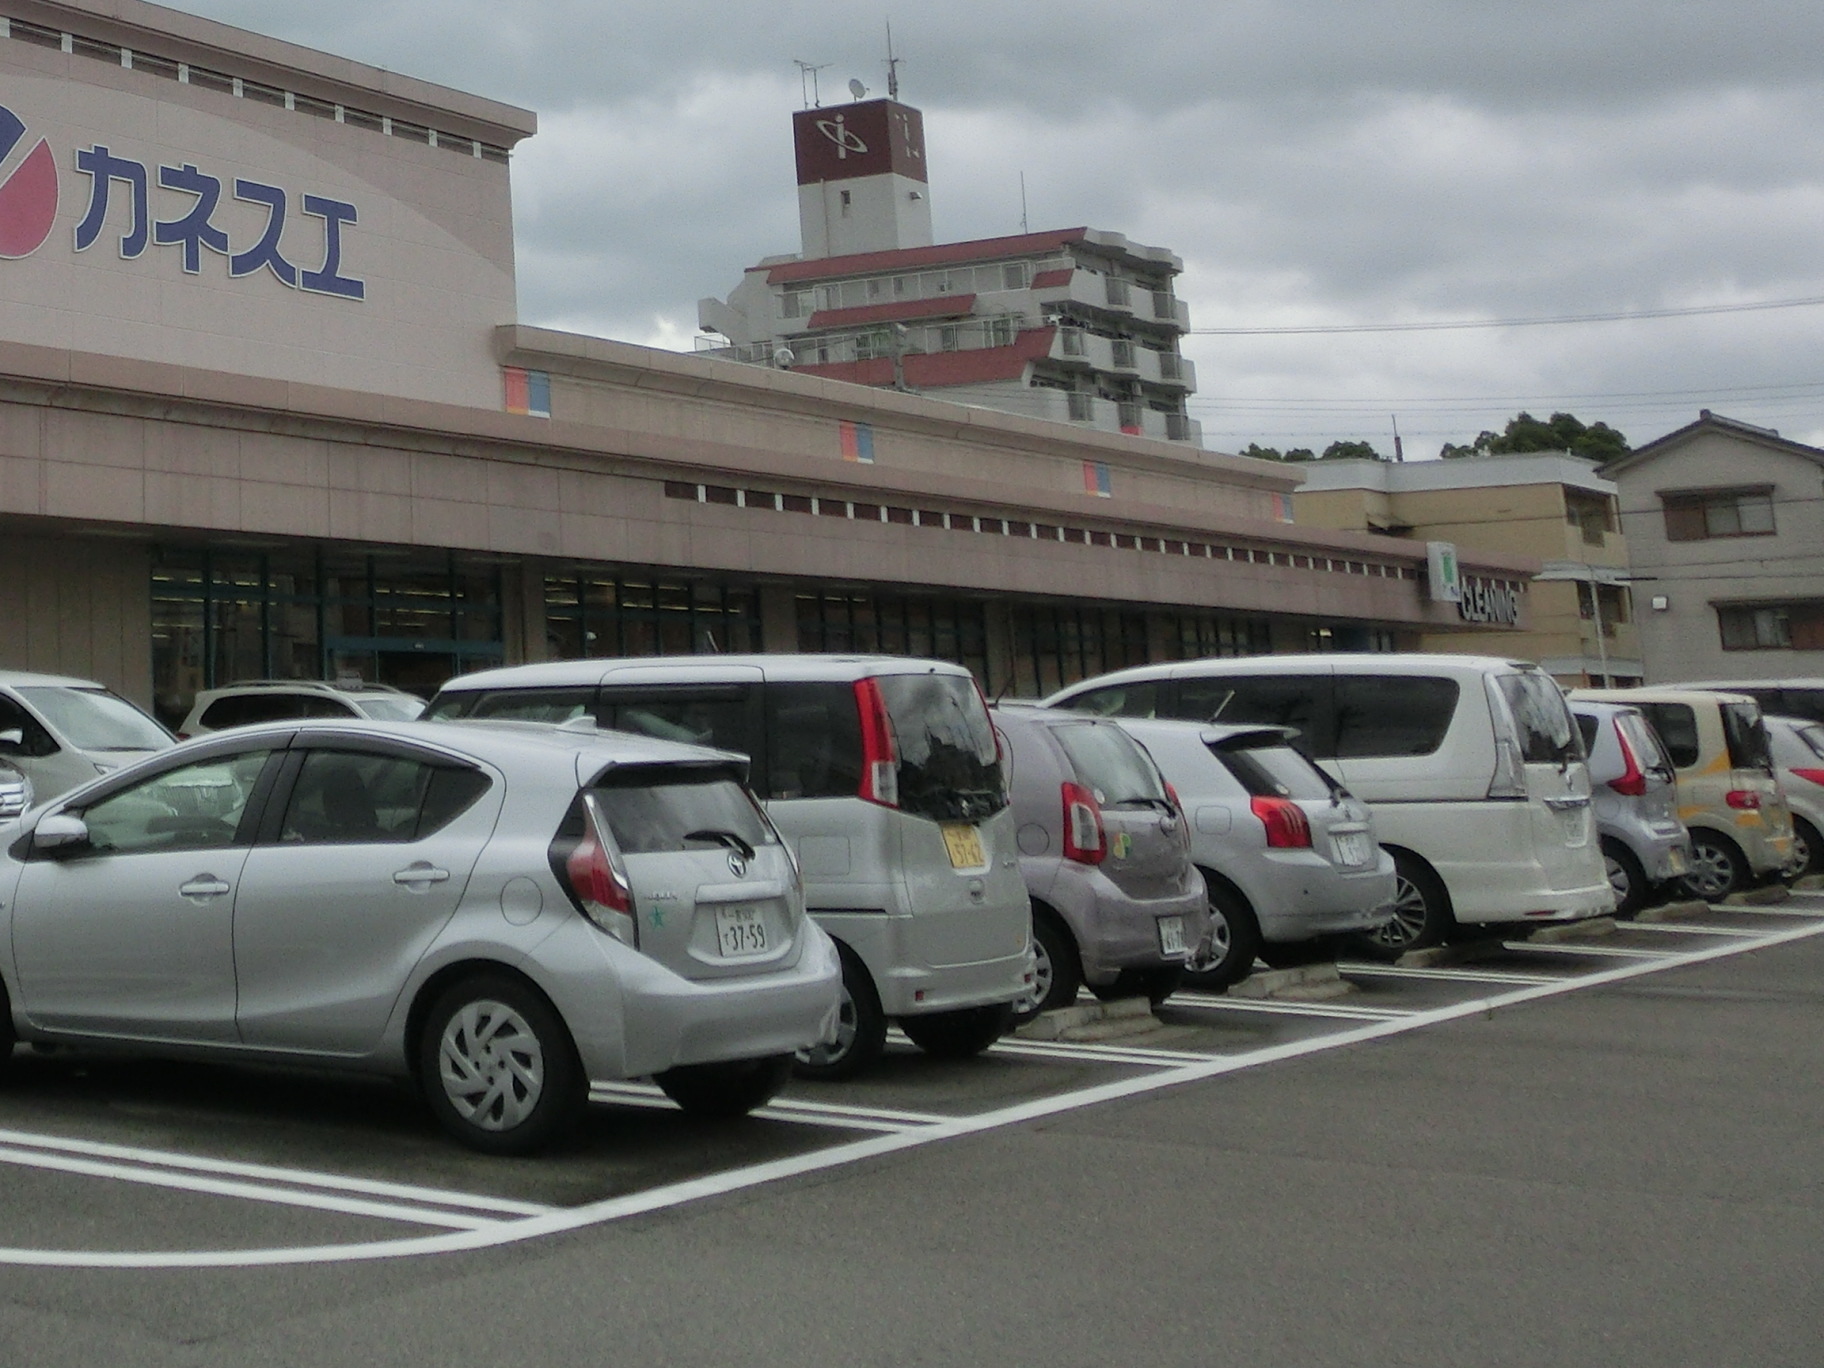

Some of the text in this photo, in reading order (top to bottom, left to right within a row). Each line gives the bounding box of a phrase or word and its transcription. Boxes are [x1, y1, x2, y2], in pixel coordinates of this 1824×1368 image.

[75, 144, 365, 301] カネスエ
[729, 923, 766, 951] 37-59
